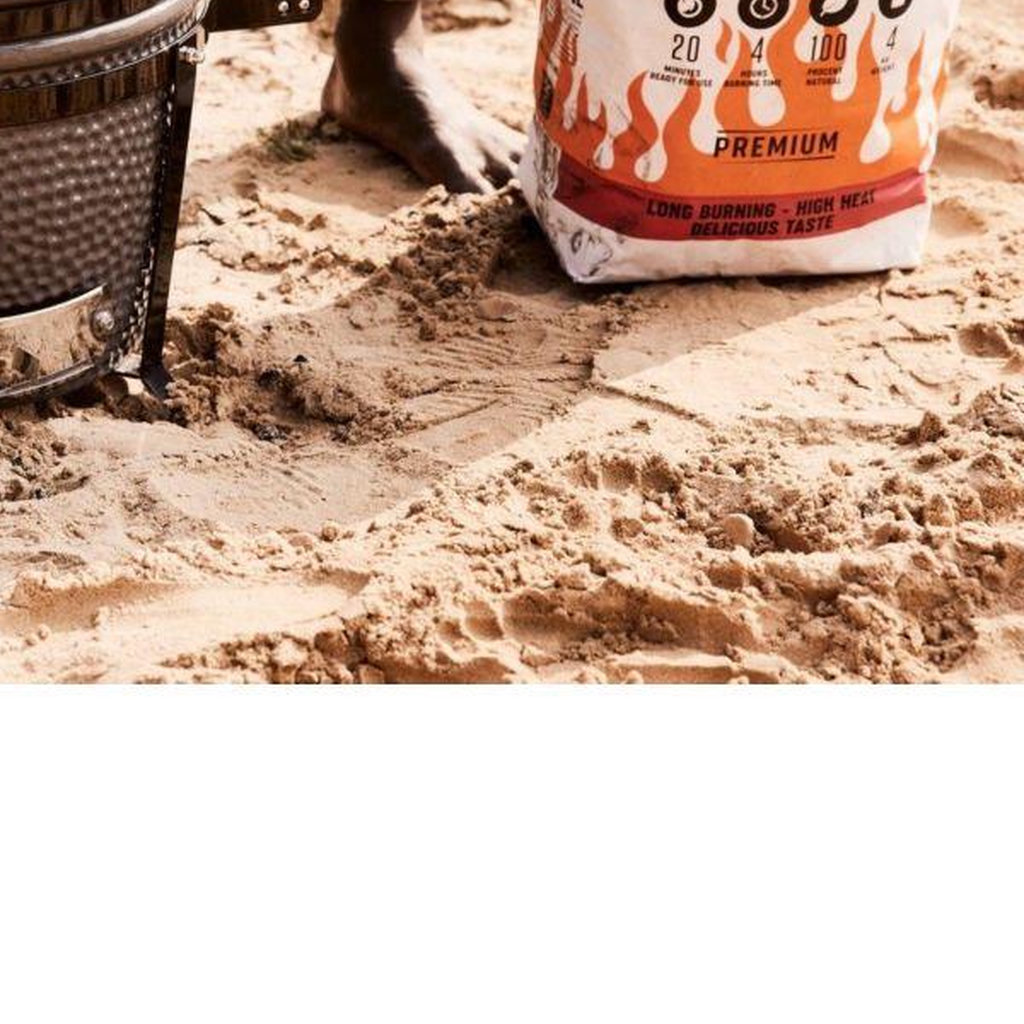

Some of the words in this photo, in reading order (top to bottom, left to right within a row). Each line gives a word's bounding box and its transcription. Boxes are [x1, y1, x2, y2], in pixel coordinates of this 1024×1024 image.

[671, 34, 700, 62] 20
[750, 37, 764, 63] 4
[811, 33, 847, 61] 100
[886, 26, 898, 50] 4
[714, 132, 839, 158] PREMIUM
[646, 199, 693, 219] LONG
[698, 202, 776, 219] BURNING
[796, 196, 835, 216] HIGH
[840, 189, 876, 210] HEAT
[690, 219, 779, 236] DELICIOUS
[786, 214, 835, 234] TASTE
